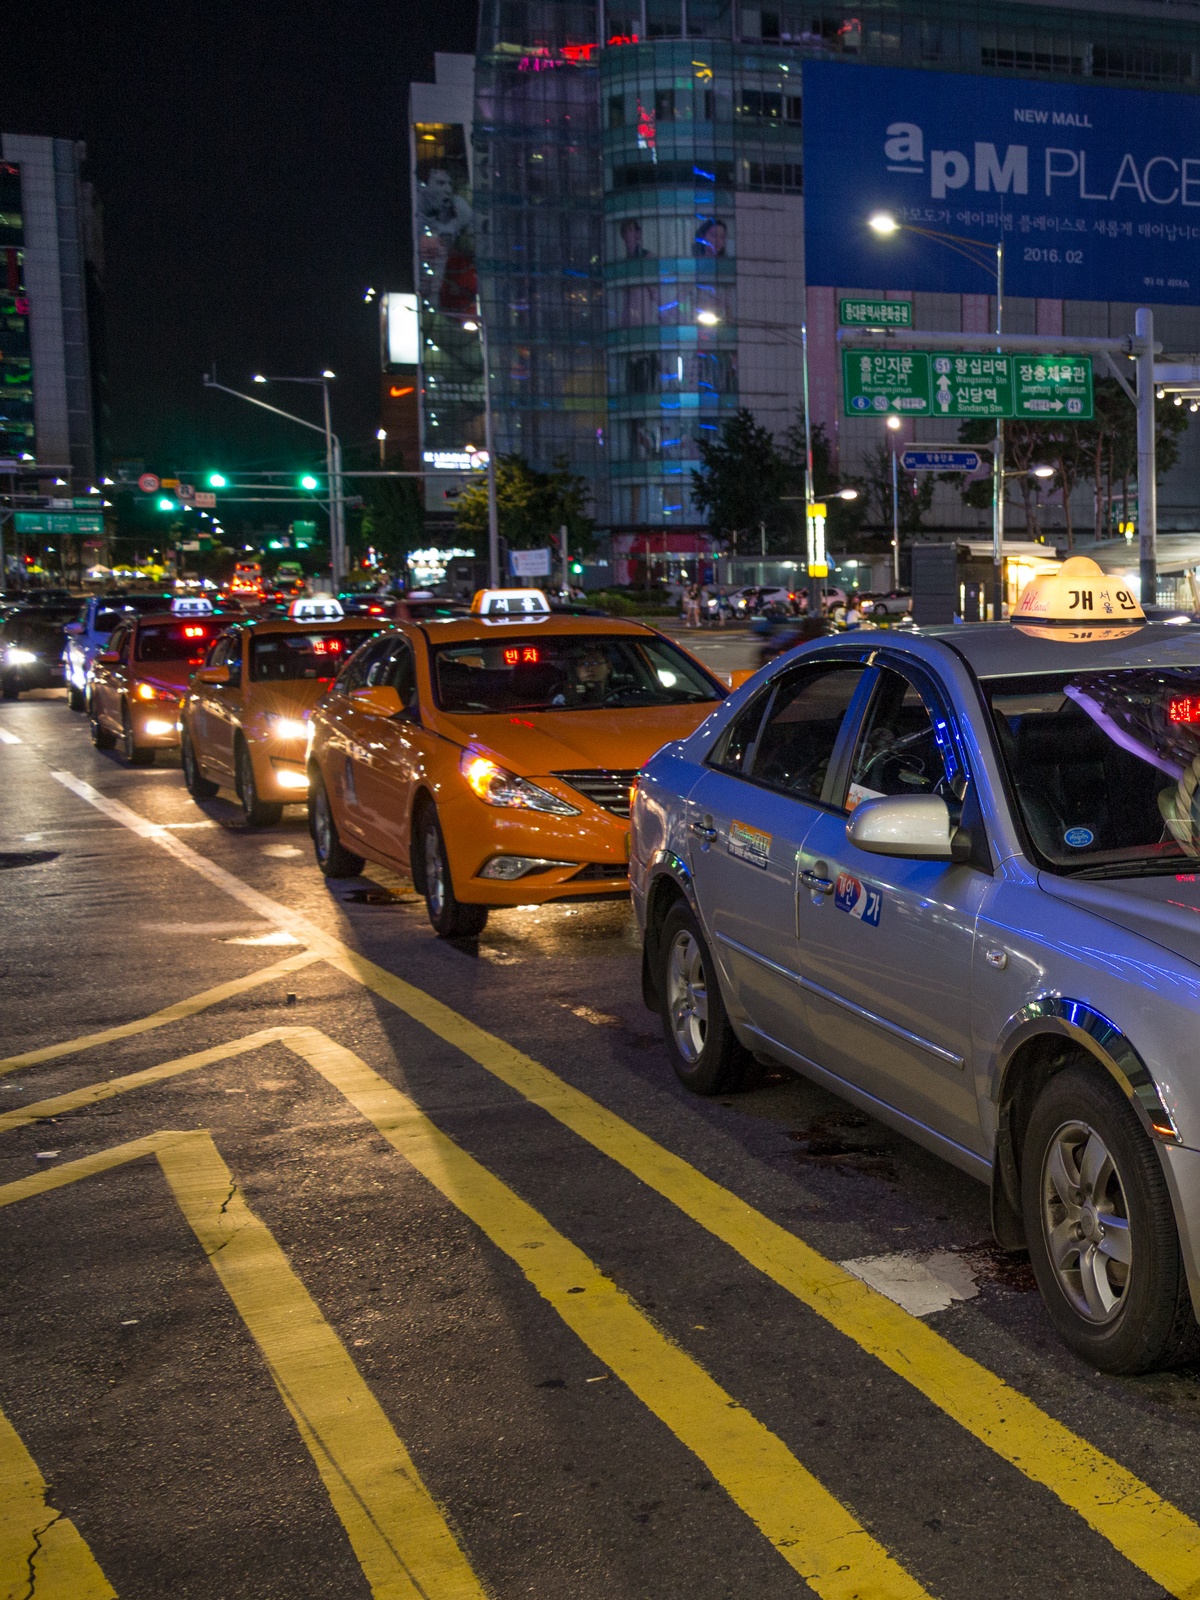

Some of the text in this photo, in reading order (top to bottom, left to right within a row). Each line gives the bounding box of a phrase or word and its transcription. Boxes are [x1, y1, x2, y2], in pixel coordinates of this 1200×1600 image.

[1013, 108, 1092, 128] NEW MALL
[884, 121, 1028, 199] apM
[956, 210, 1014, 232] 에이피엠
[1018, 213, 1088, 234] 플레이스로
[1093, 218, 1134, 238] 새롭게
[1023, 247, 1084, 264] 2016. 02
[845, 303, 908, 323] 동대문역사문화공원
[859, 356, 914, 374] 흥인지문
[937, 360, 949, 372] 51
[954, 358, 1007, 376] 왕십리역
[1019, 365, 1086, 383] 장충체육관
[857, 398, 865, 408] 6
[956, 387, 997, 404] 신당역
[957, 403, 1004, 414] Sindang Stn
[1069, 401, 1080, 411] 41
[866, 892, 880, 921] 가
